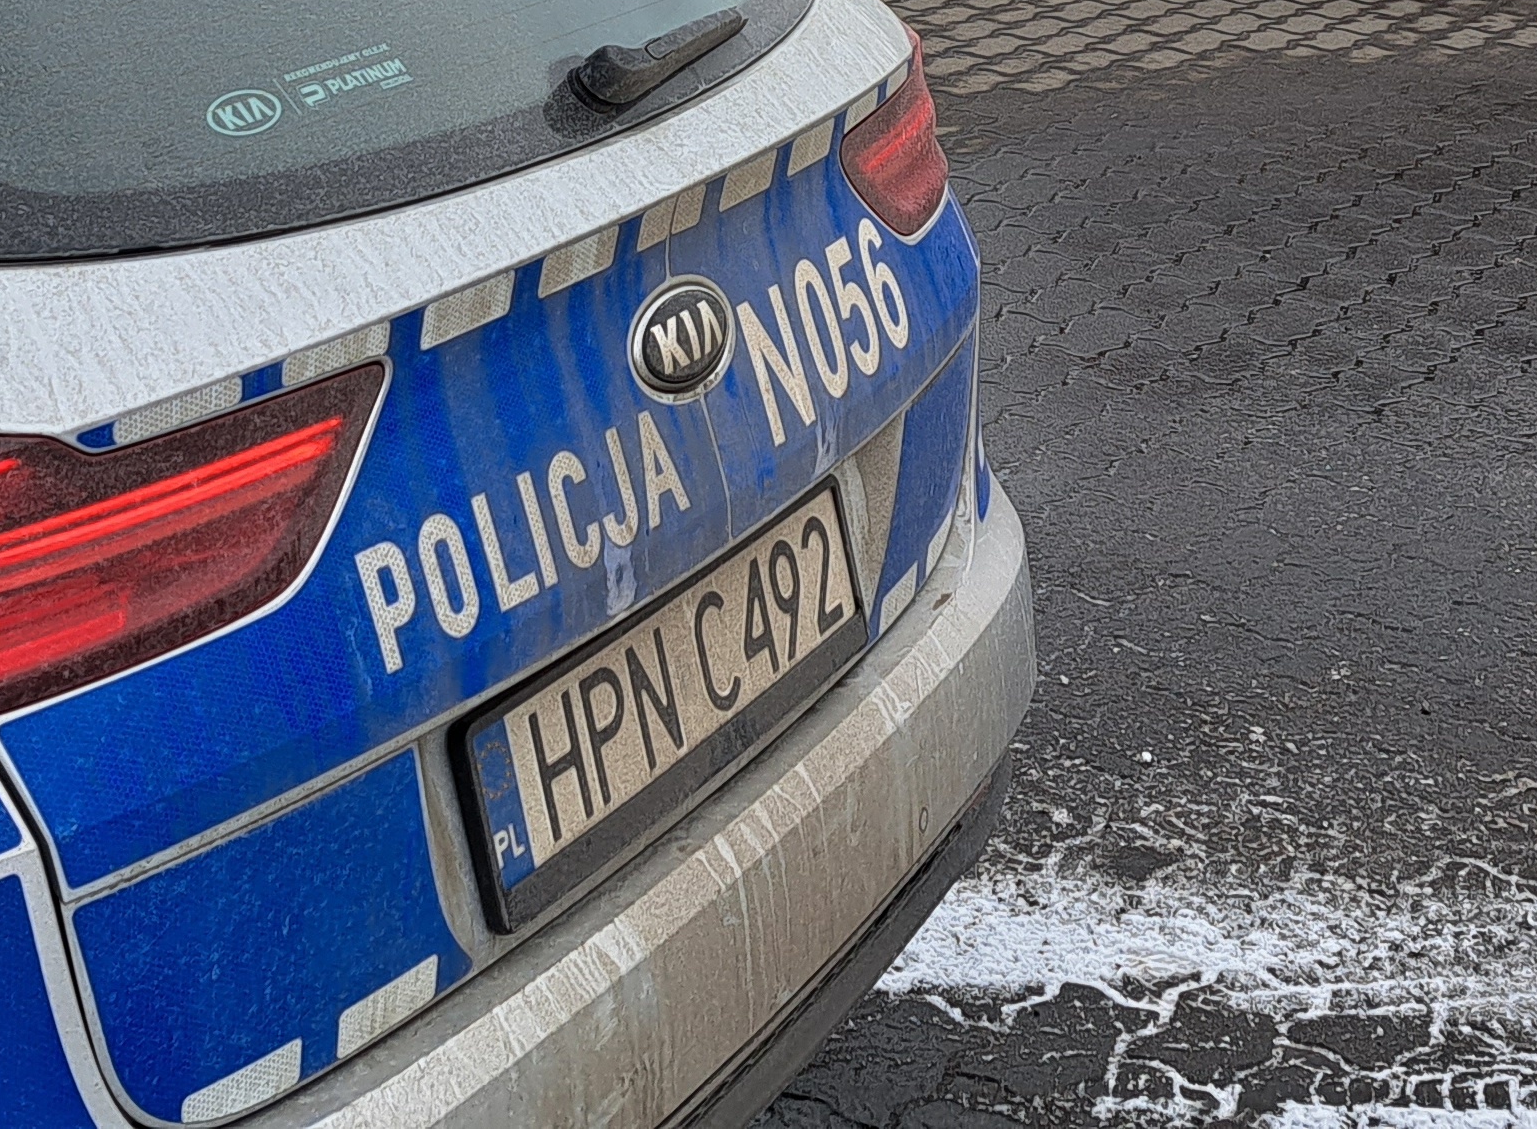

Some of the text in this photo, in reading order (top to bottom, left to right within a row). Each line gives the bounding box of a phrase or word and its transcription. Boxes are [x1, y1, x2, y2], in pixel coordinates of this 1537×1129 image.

[216, 97, 275, 132] KIA
[324, 58, 407, 95] PLATINUM
[652, 299, 726, 377] KIA
[737, 218, 910, 447] N056
[354, 411, 692, 675] POLICJA
[529, 515, 845, 842] HPN C492
[493, 823, 526, 870] PL
